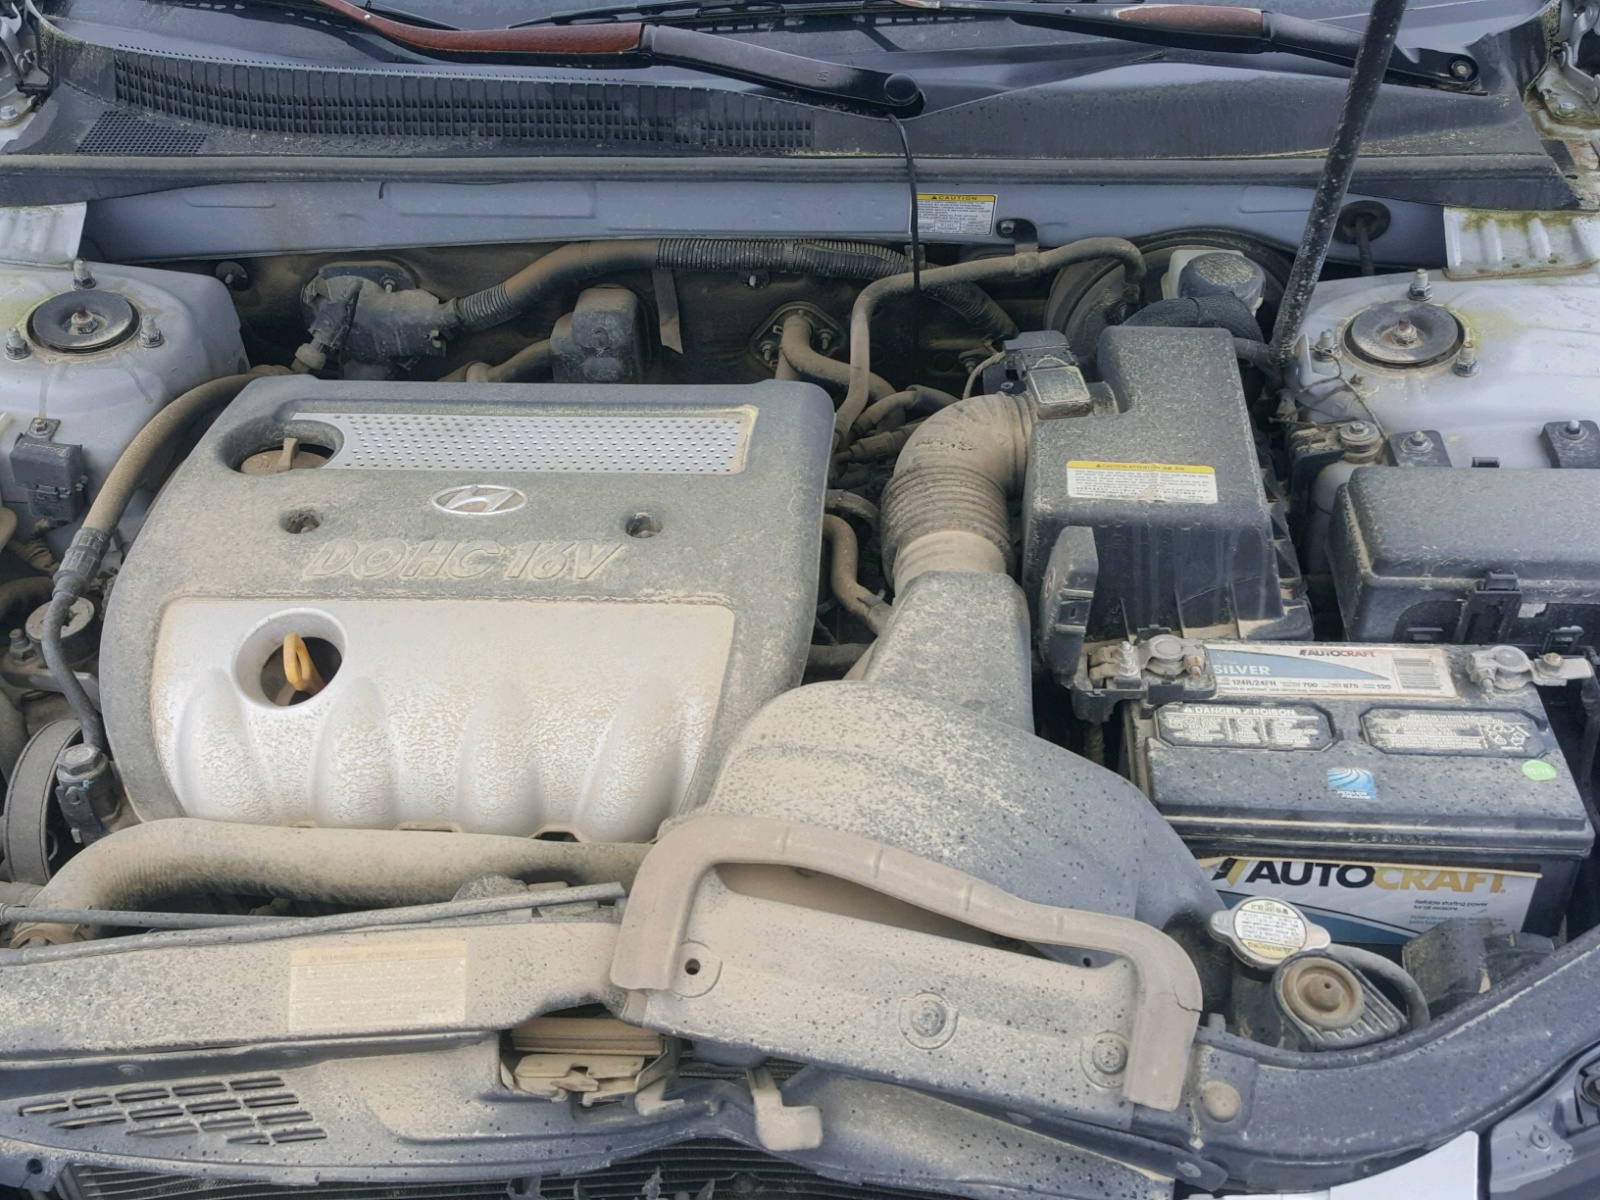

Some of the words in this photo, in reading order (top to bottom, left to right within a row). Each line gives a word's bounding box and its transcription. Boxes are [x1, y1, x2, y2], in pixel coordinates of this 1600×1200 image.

[304, 539, 499, 579] DOHC
[505, 541, 623, 580] 16V
[1307, 649, 1375, 657] AUTOCRAFT
[1212, 664, 1271, 676] SILVER
[1245, 861, 1504, 893] AUTOCRAFT
